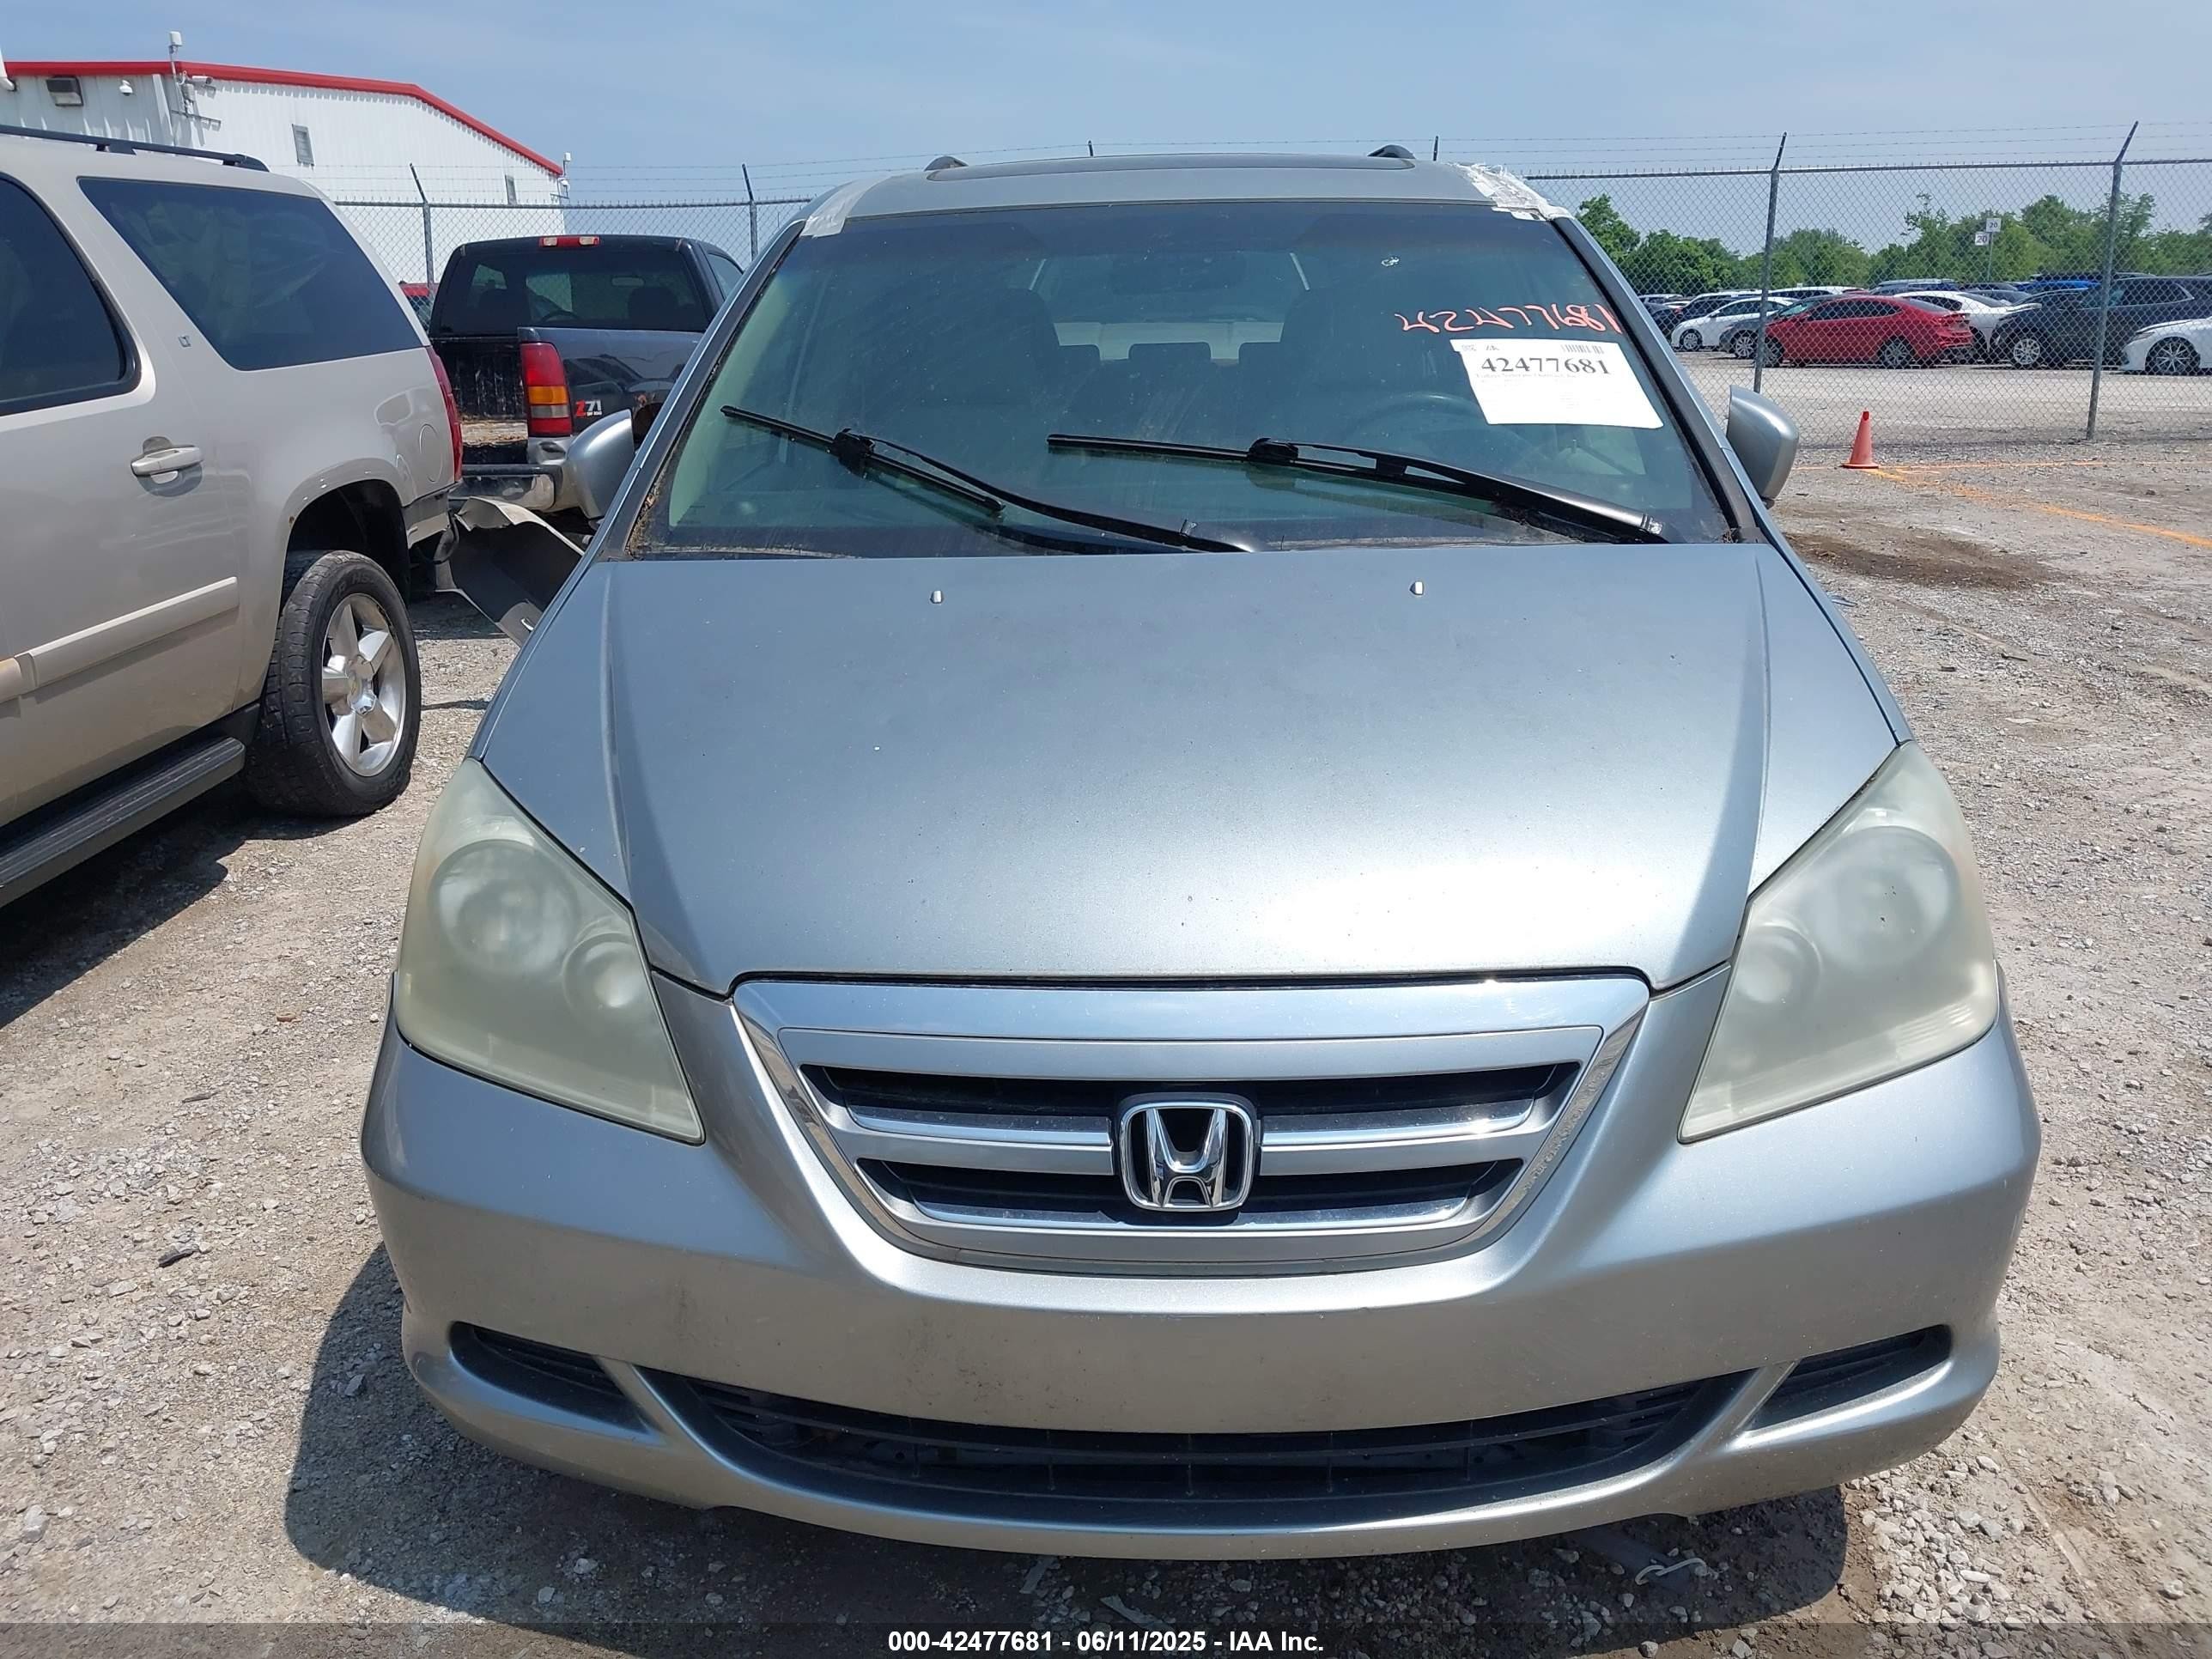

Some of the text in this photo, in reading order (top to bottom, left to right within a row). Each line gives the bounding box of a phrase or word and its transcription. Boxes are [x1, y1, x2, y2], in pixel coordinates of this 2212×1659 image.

[1977, 235, 1988, 244] 20
[1480, 356, 1611, 375] 42477681
[576, 398, 602, 417] Z71
